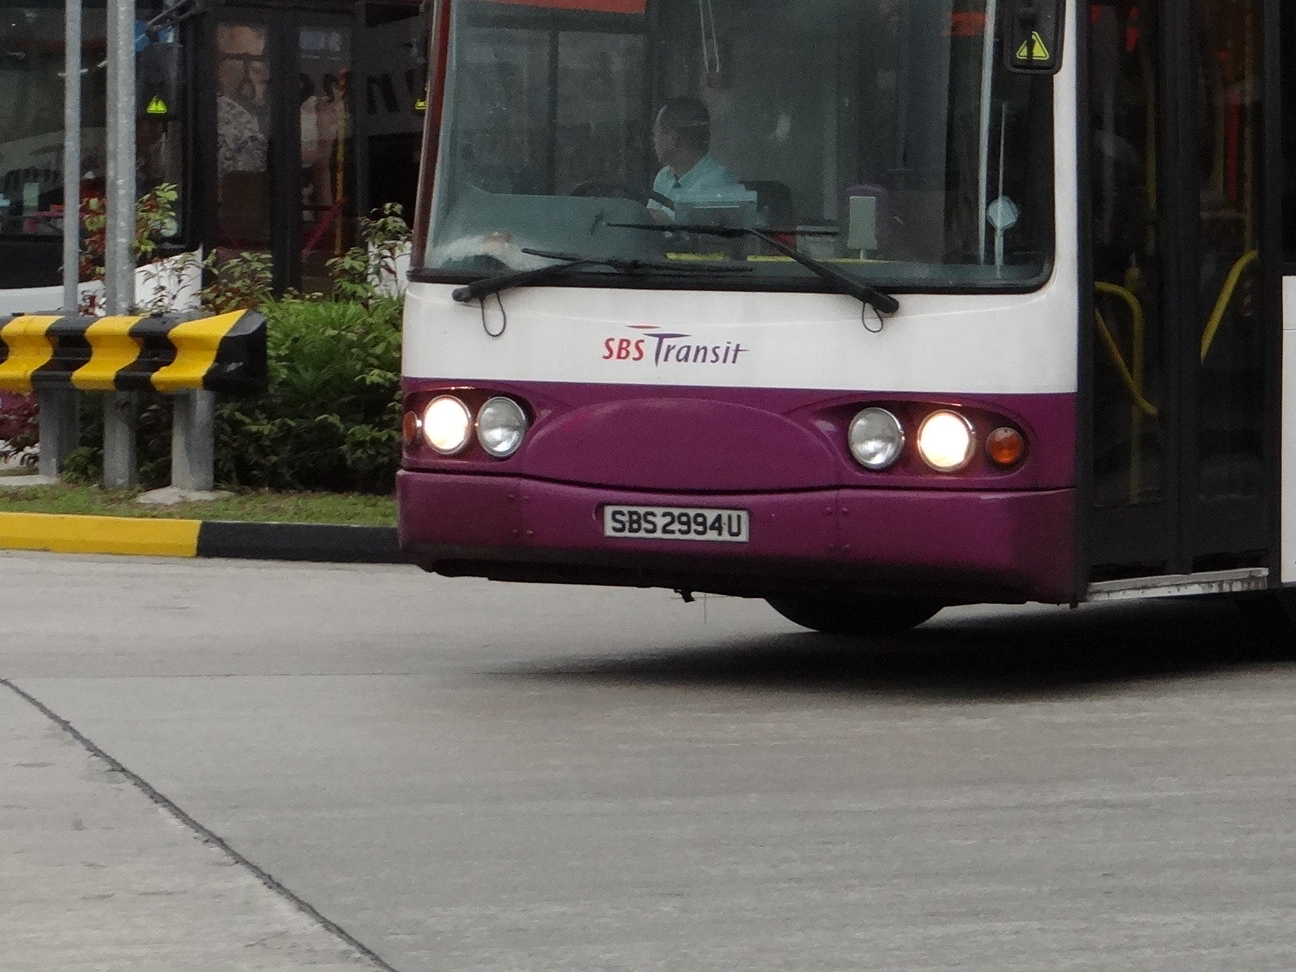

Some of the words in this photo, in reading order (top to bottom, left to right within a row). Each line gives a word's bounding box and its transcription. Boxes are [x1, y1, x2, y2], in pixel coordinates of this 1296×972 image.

[602, 338, 645, 361] SBS
[643, 333, 750, 367] Transit
[610, 510, 742, 537] SBS2994U
